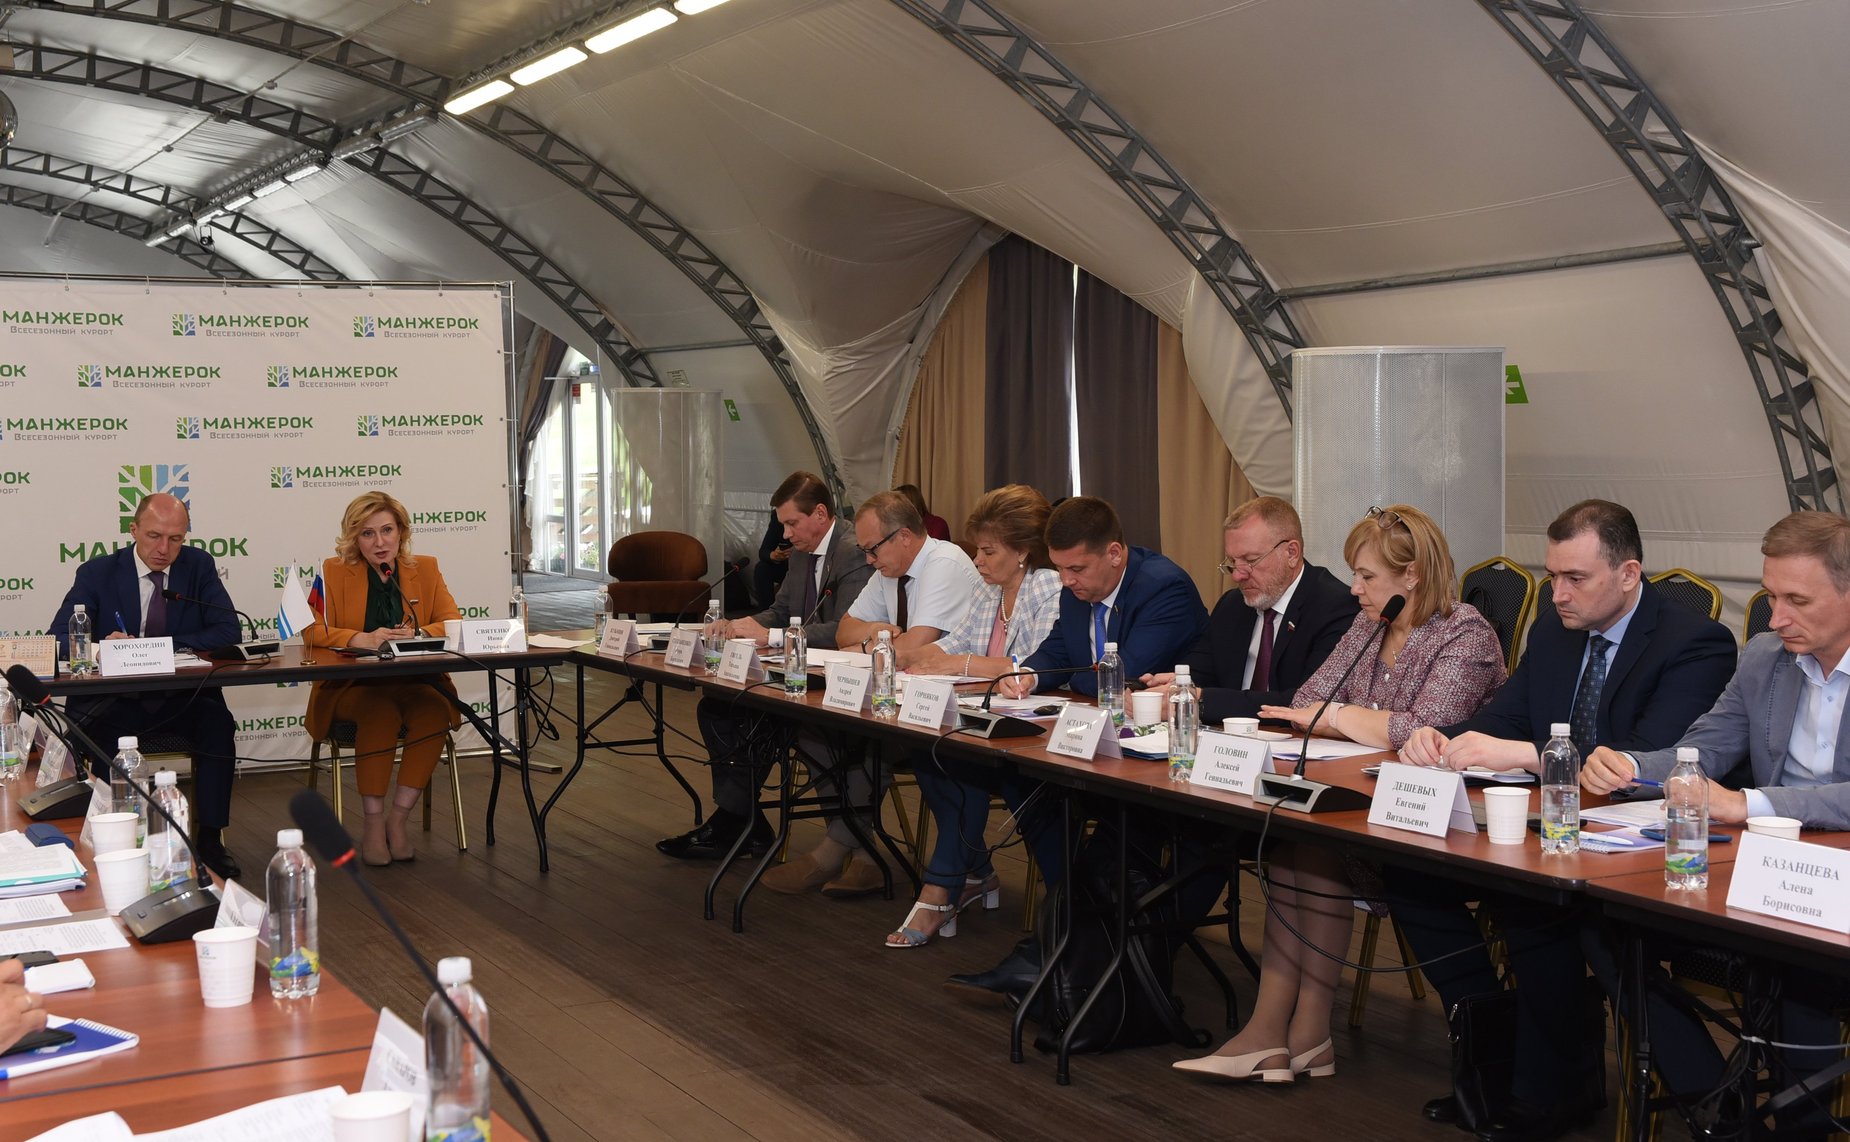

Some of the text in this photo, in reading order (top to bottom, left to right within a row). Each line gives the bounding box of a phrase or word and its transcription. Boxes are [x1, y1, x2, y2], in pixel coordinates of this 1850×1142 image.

[2, 310, 124, 326] МАНЖЕРОК
[199, 314, 310, 328] МАНЖЕРОК
[377, 316, 479, 330] МАНЖЕРОК
[105, 365, 222, 379] МАНЖЕРОК
[292, 366, 399, 378] МАНЖЕРОК
[6, 417, 129, 431] МАНЖЕРОК
[203, 416, 314, 430] МАНЖЕРОК
[381, 414, 484, 427] МАНЖЕРОК
[296, 464, 402, 478] МАНЖЕРОК
[411, 510, 487, 524] НЖЕРОК
[113, 641, 166, 650] ХОРОХОРДИН
[1213, 745, 1249, 759] ГОЛОВИН
[1215, 760, 1240, 772] Алексей
[1204, 772, 1244, 788] Геннадьевич
[1391, 780, 1438, 797] ДЕШЕВЫХ
[1395, 797, 1427, 811] Евгений
[1385, 811, 1430, 829] Витальевич
[1761, 855, 1840, 881] КАЗАНЦЕВА
[1778, 879, 1814, 896] Алена
[1761, 895, 1823, 918] Борисовна
